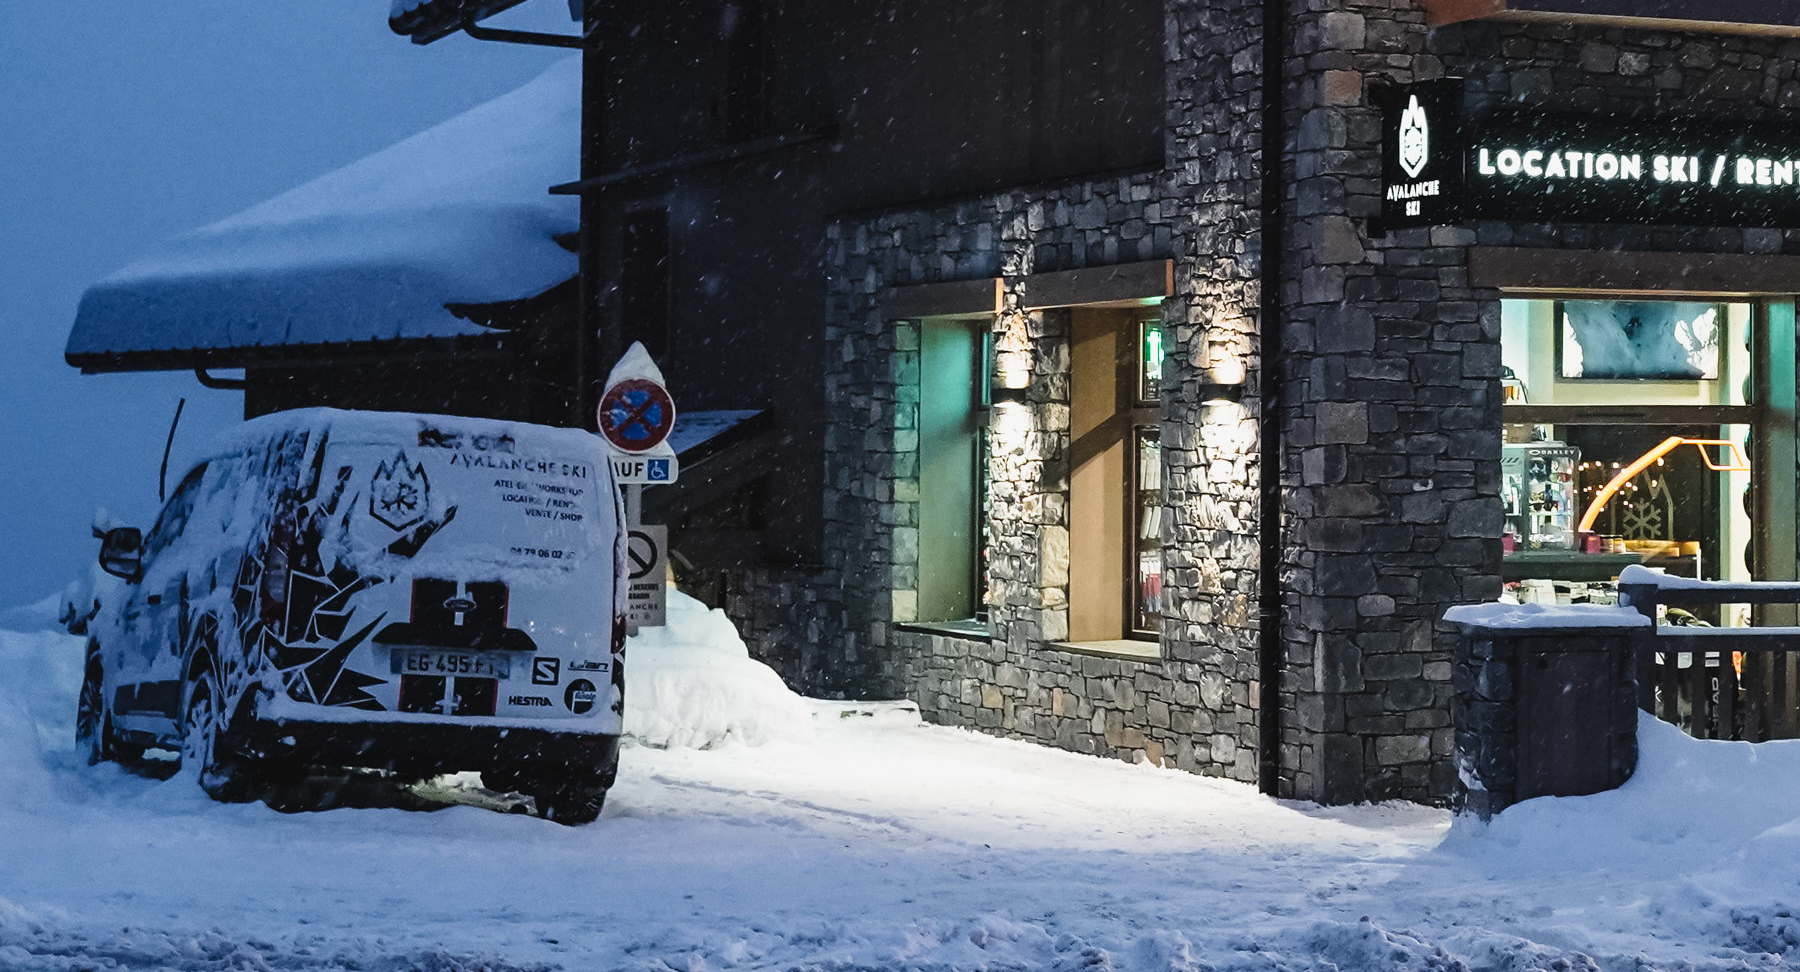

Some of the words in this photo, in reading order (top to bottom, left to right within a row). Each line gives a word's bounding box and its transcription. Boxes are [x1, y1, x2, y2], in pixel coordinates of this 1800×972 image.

[1479, 149, 1643, 181] LOCATION
[1653, 154, 1699, 184] SKI
[1709, 161, 1727, 187] /
[1386, 179, 1440, 202] AVALANCHE
[1405, 200, 1420, 217] SKI
[525, 508, 552, 519] VENTE
[560, 512, 583, 521] SHOP
[538, 549, 550, 558] 06
[552, 550, 563, 558] 02
[508, 695, 553, 707] HESTRA
